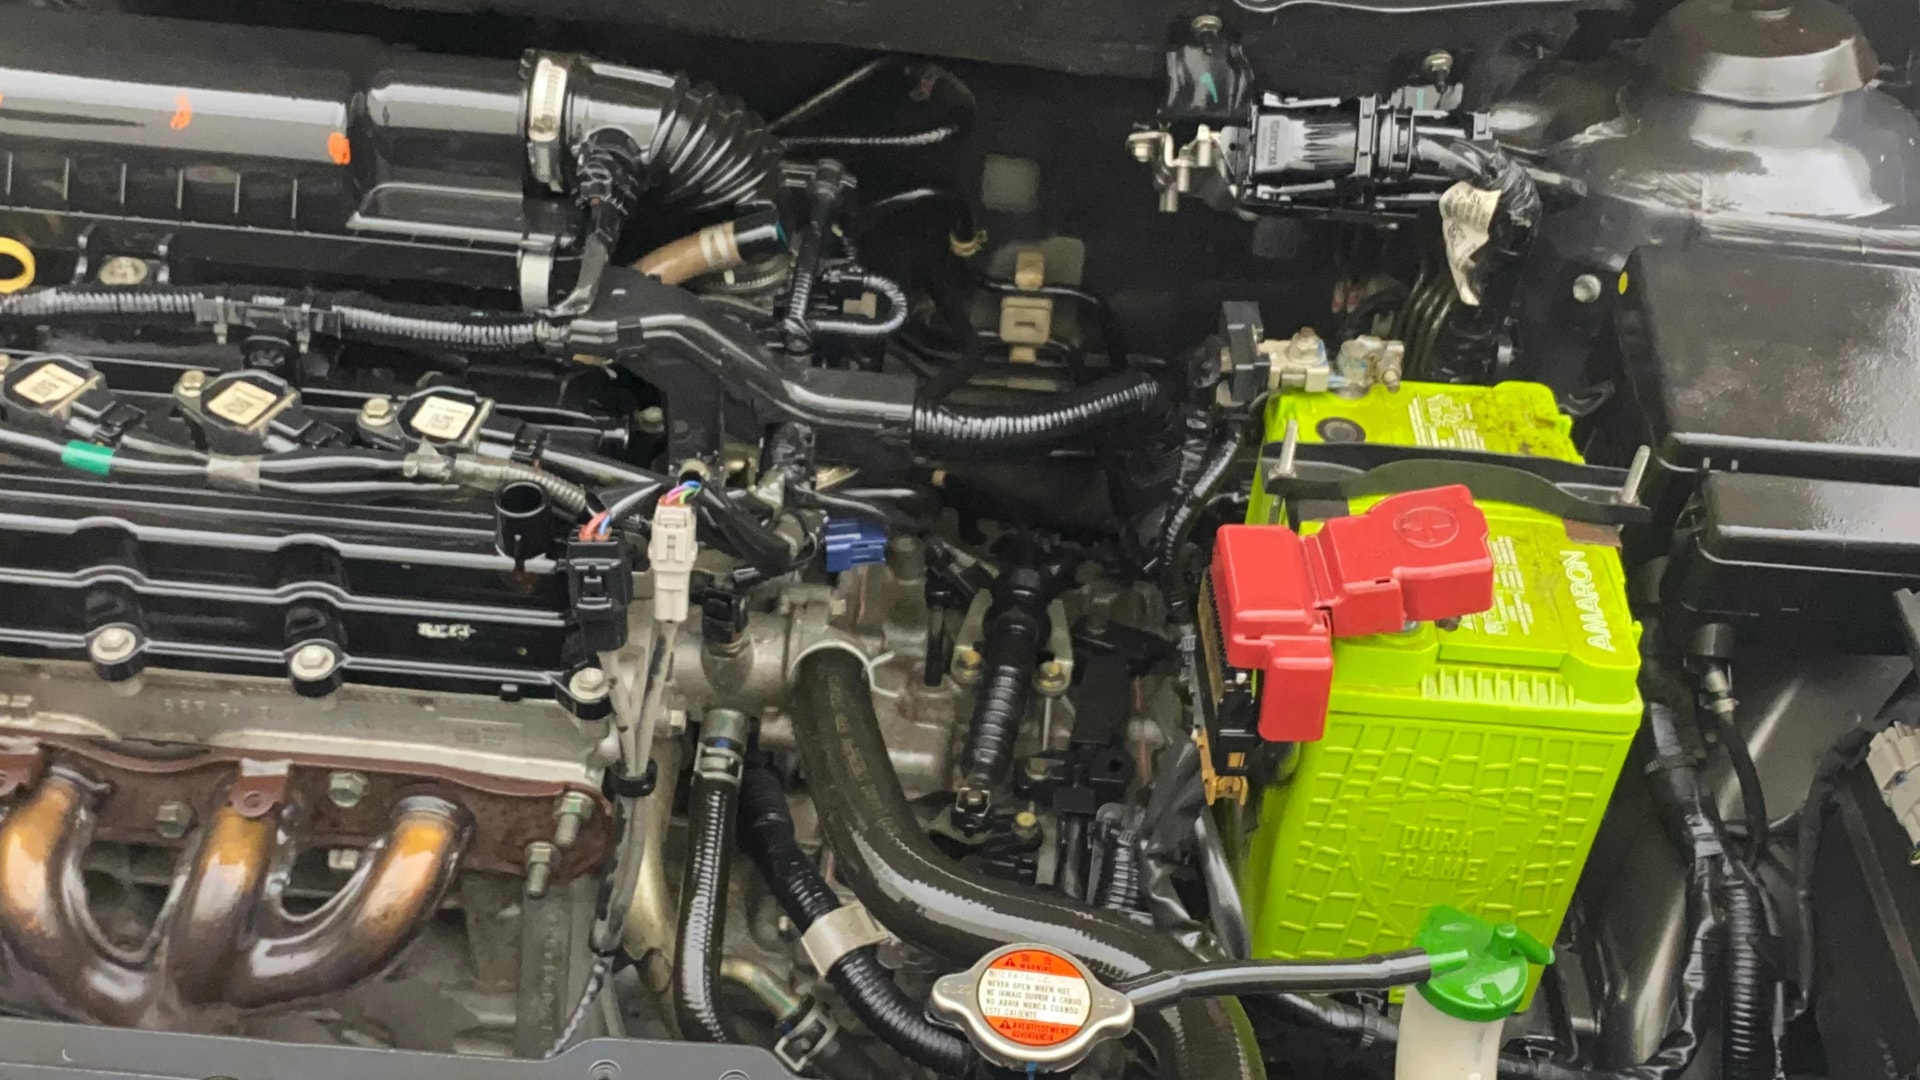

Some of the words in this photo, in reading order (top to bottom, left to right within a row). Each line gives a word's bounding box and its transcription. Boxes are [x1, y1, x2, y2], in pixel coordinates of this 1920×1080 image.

[1560, 550, 1616, 652] AMARON
[1400, 826, 1473, 854] DURA
[1381, 852, 1486, 881] FRAME
[988, 980, 1010, 988] NEVER
[1035, 985, 1054, 993] WHEN
[1023, 1002, 1046, 1010] NUNCA
[1050, 1004, 1079, 1014] CUANDO
